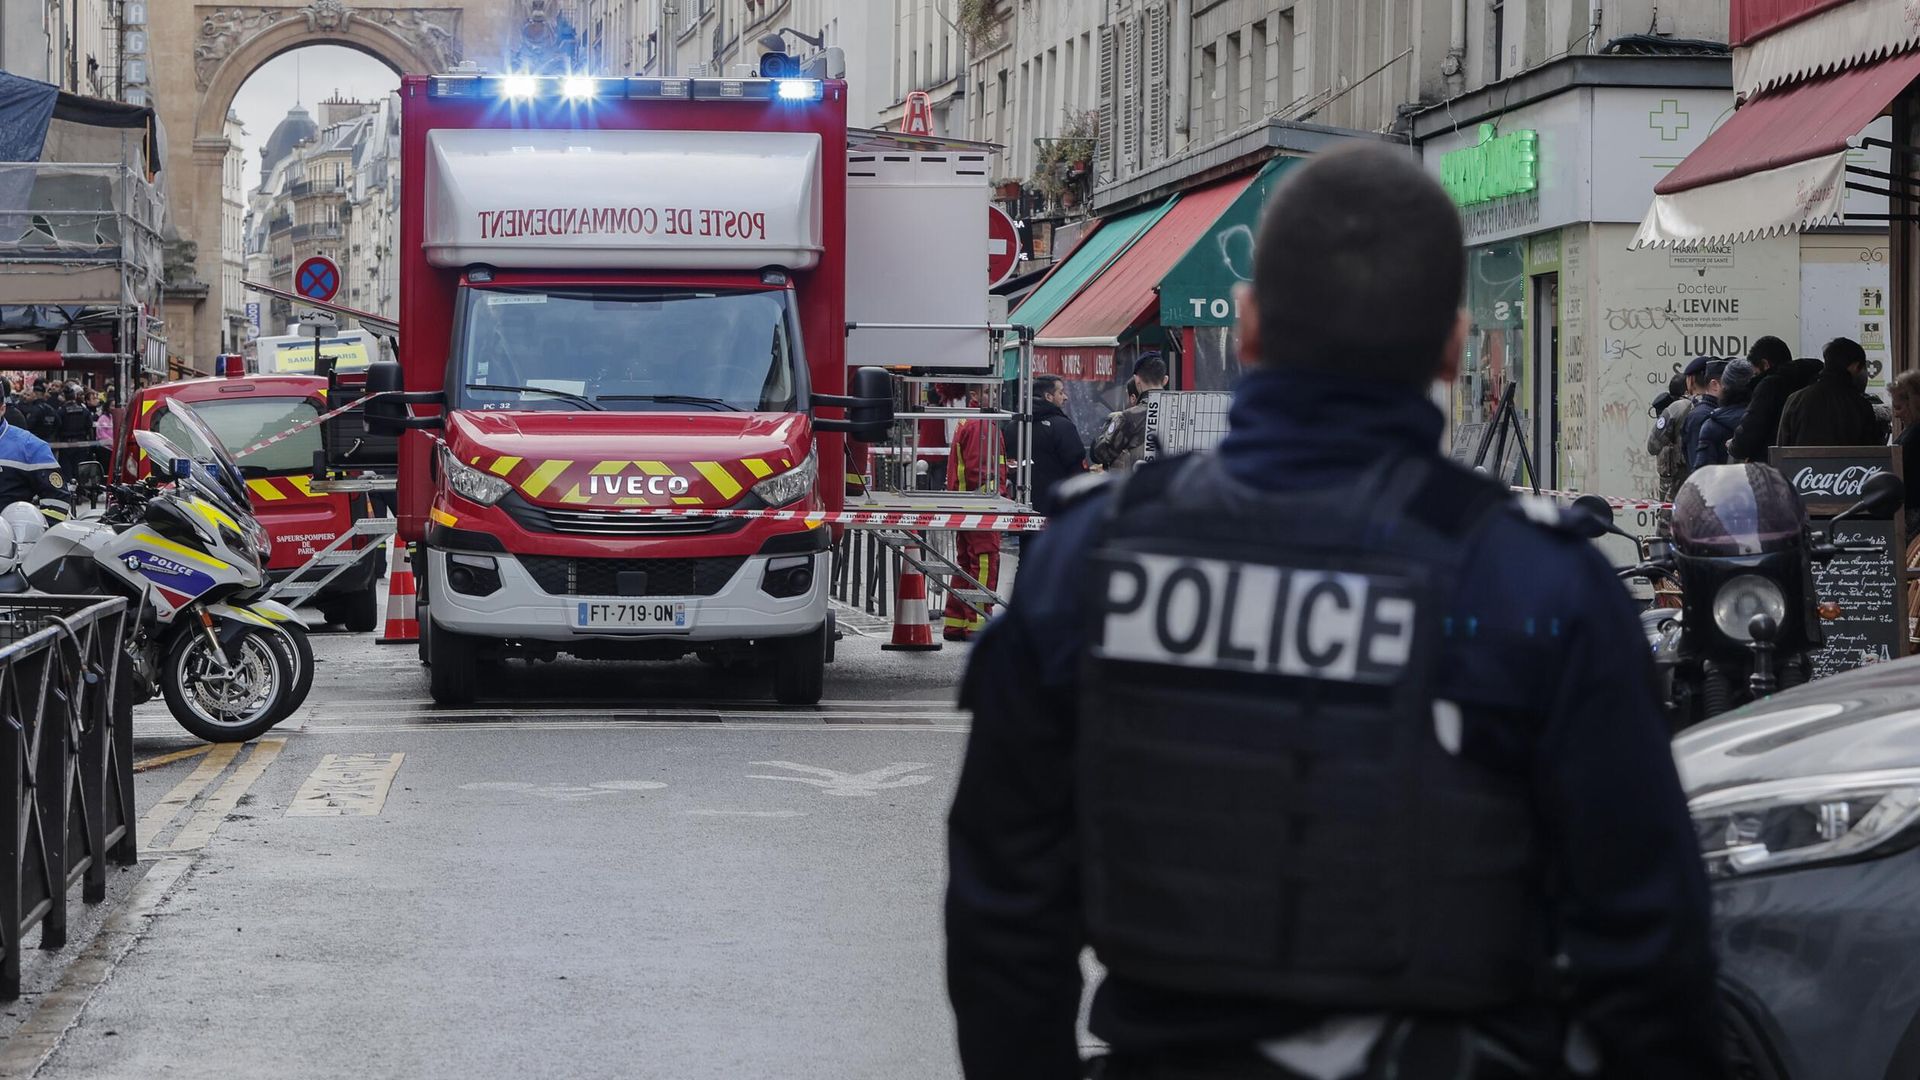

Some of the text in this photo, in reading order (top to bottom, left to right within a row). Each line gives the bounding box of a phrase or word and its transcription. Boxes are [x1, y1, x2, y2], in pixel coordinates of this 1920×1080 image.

[1677, 283, 1728, 294] Docteur
[1683, 299, 1739, 313] LEVINE
[1656, 335, 1748, 356] du LUNDI
[1647, 371, 1667, 384] au
[590, 475, 689, 495] IVECO
[1792, 466, 1890, 496] Coca-Col
[301, 540, 311, 548] DE
[149, 555, 194, 577] POLICE
[590, 604, 674, 622] FT-719-QN
[1098, 558, 1413, 678] POLICE
